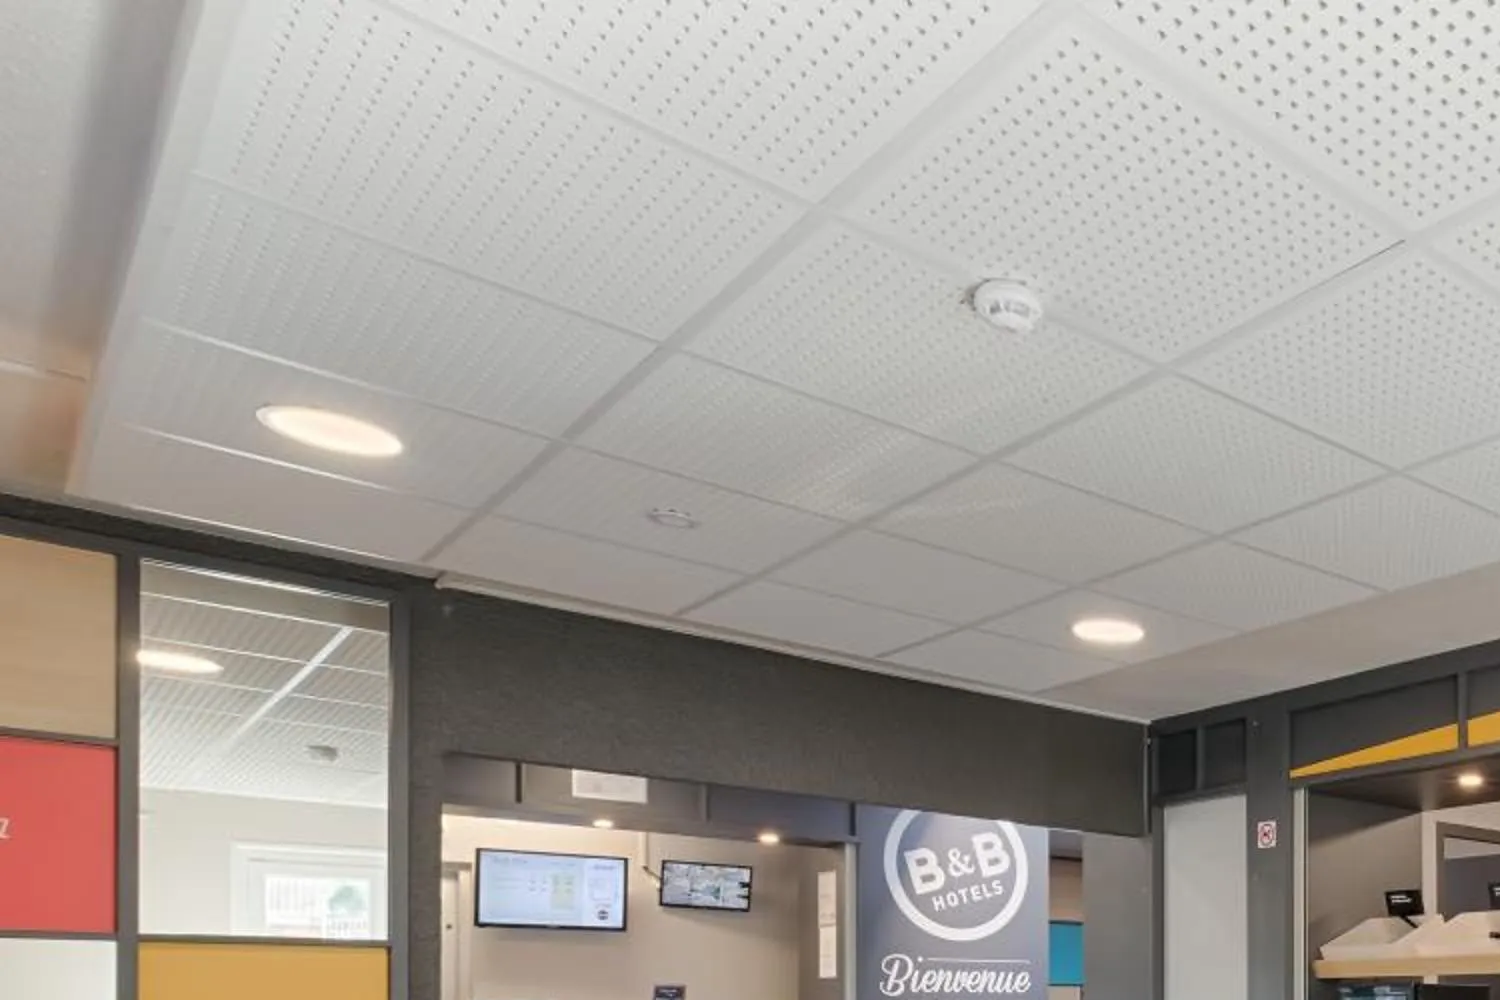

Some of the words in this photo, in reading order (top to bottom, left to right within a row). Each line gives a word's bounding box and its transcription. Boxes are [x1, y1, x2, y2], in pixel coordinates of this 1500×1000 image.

[903, 831, 1011, 895] B&B
[931, 879, 1005, 912] HOTELS
[879, 953, 1032, 996] Bienvenue
